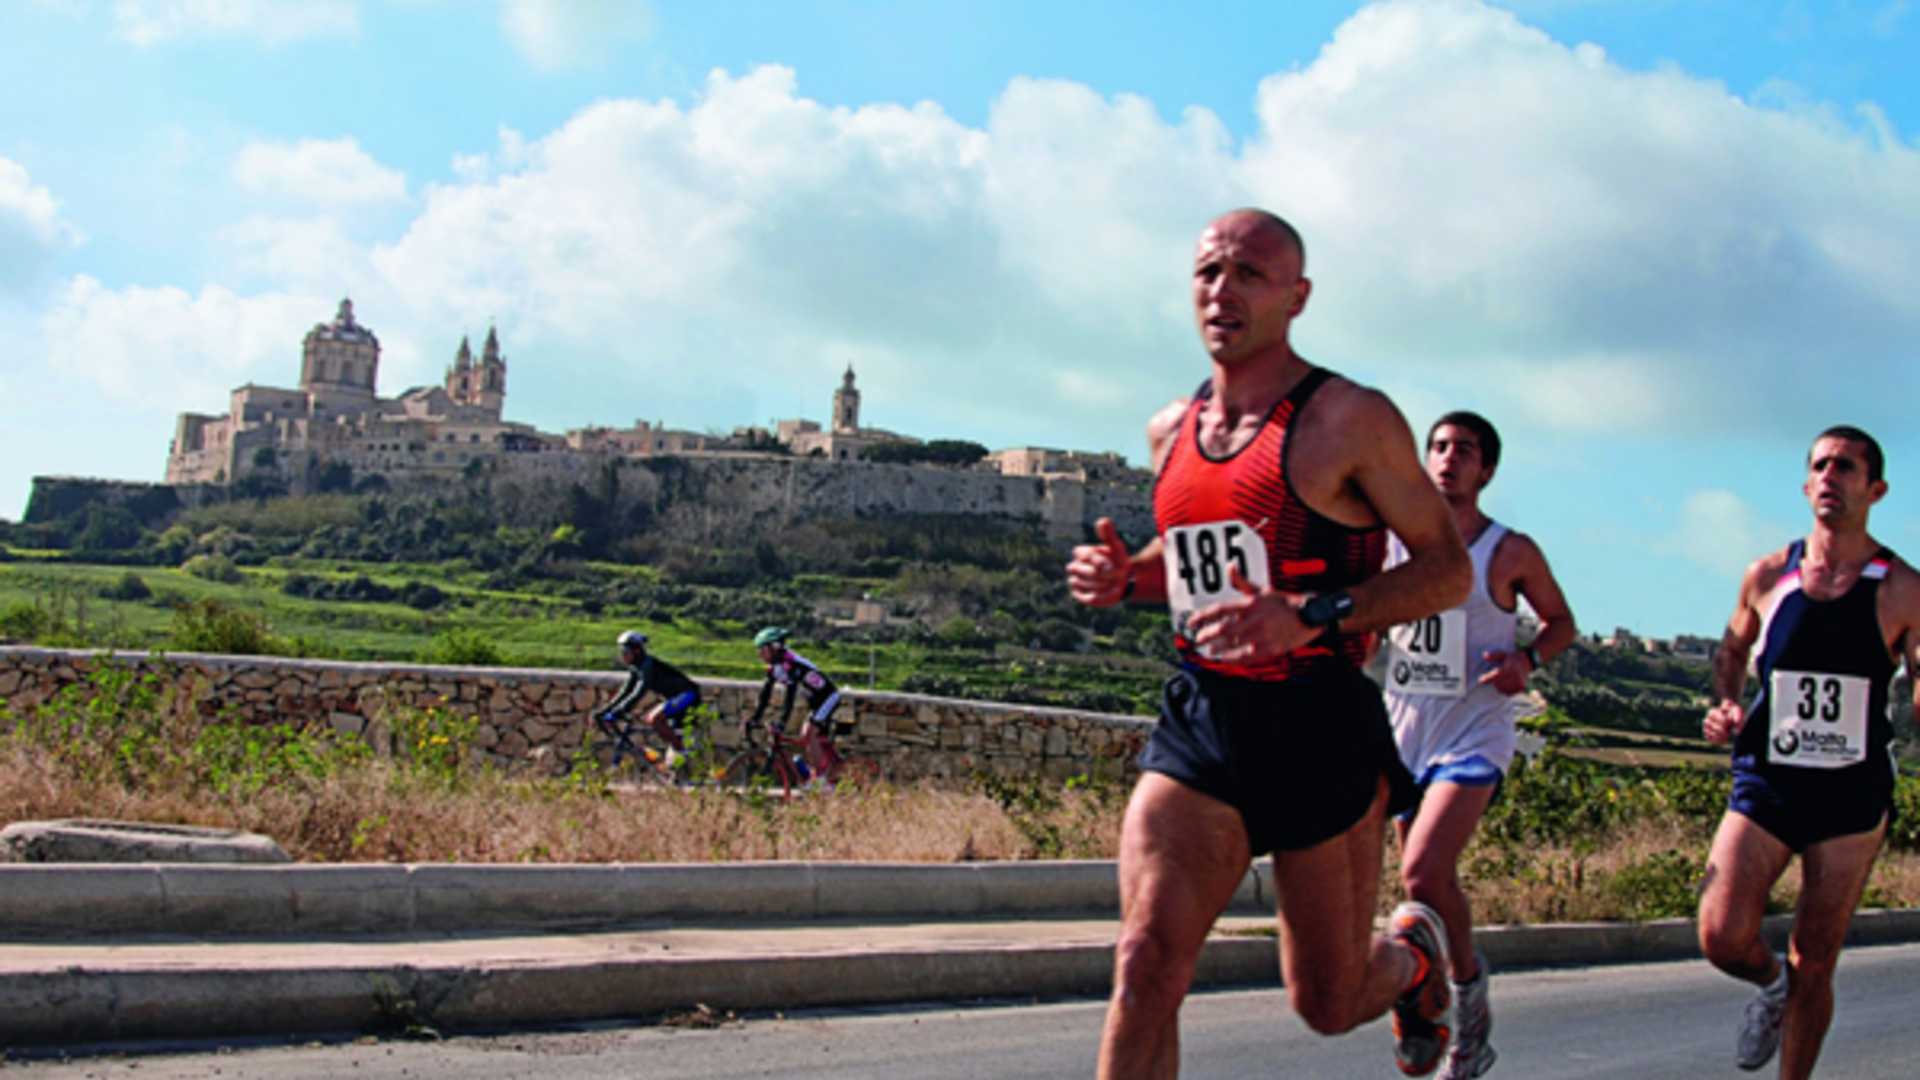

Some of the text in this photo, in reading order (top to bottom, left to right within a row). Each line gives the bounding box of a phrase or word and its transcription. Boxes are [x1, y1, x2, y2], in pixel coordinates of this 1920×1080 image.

[1174, 525, 1249, 595] 485
[1408, 613, 1442, 654] 20
[1797, 676, 1842, 722] 33
